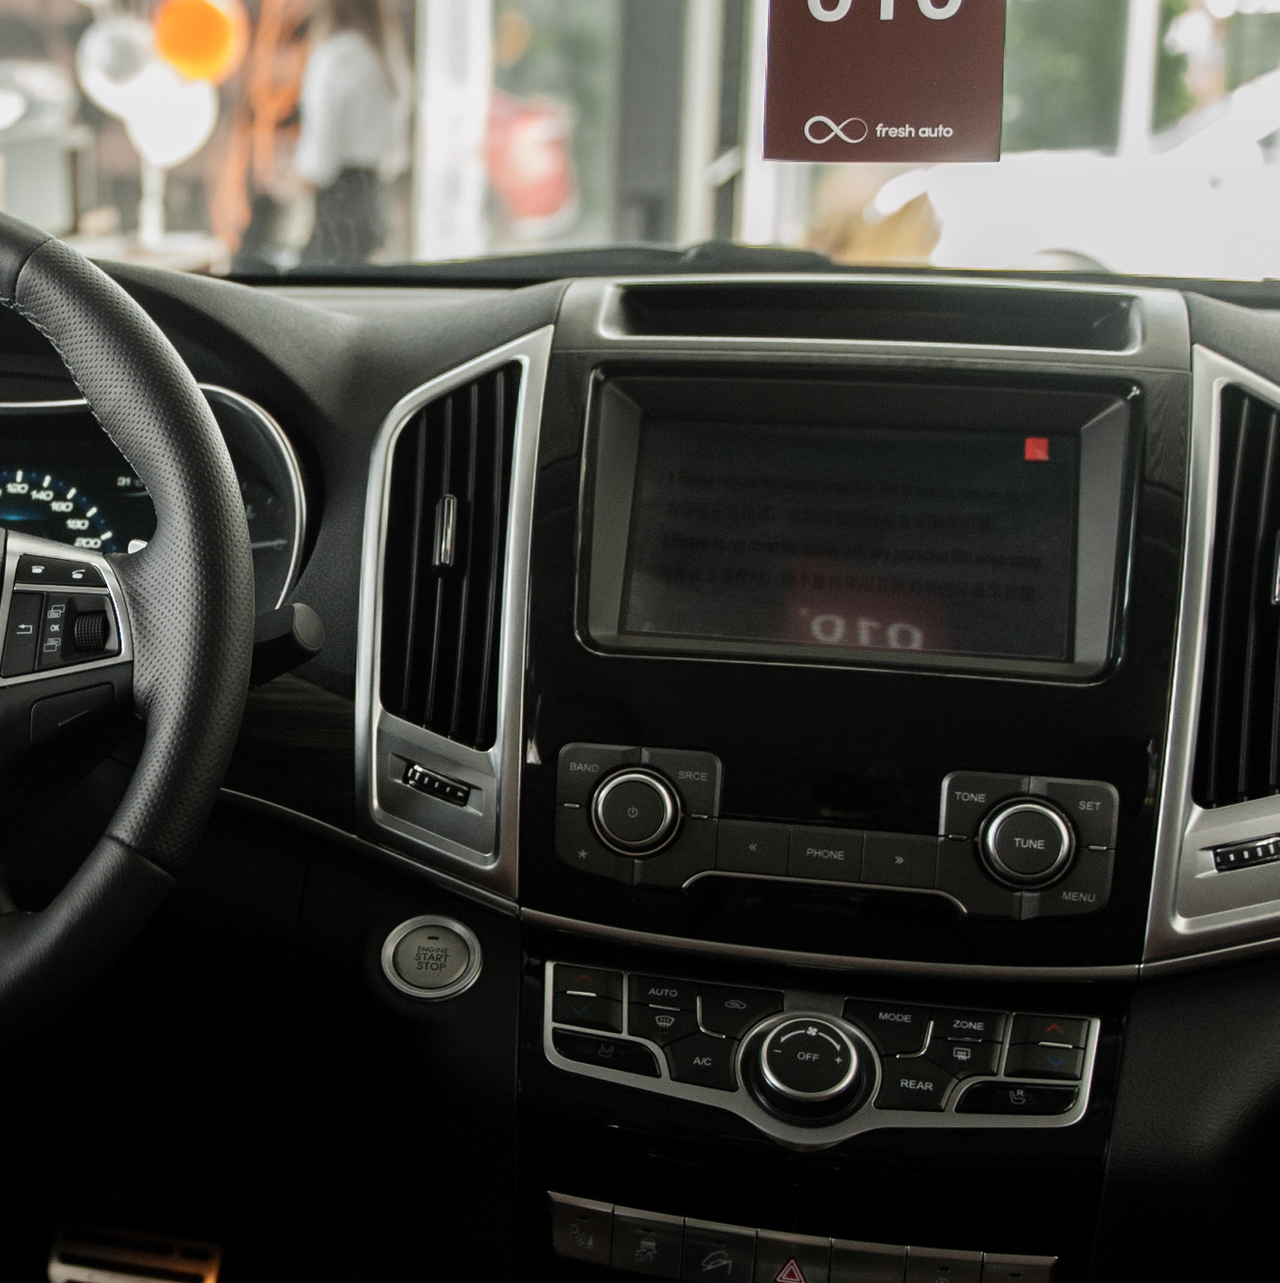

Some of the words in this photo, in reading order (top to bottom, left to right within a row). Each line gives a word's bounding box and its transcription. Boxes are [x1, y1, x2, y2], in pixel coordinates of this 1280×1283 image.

[875, 122, 915, 138] fresh
[918, 123, 954, 138] auto
[30, 489, 54, 502] 140
[74, 537, 102, 549] 200
[49, 623, 61, 632] OK
[569, 762, 600, 773] BAND
[678, 770, 708, 782] SRCE
[955, 791, 987, 803] TONE
[1078, 800, 1102, 812] SET
[1013, 837, 1046, 850] TUNE
[806, 847, 846, 861] PHONE
[1062, 890, 1096, 903] MENU
[417, 945, 449, 954] ENGINE
[414, 953, 450, 963] START
[416, 961, 447, 971] STOP
[648, 987, 679, 997] AUTO
[878, 1011, 912, 1023] MODE
[952, 1019, 985, 1031] ZONE
[693, 1056, 712, 1066] A/C
[796, 1051, 820, 1062] OFF
[900, 1079, 934, 1091] REAR
